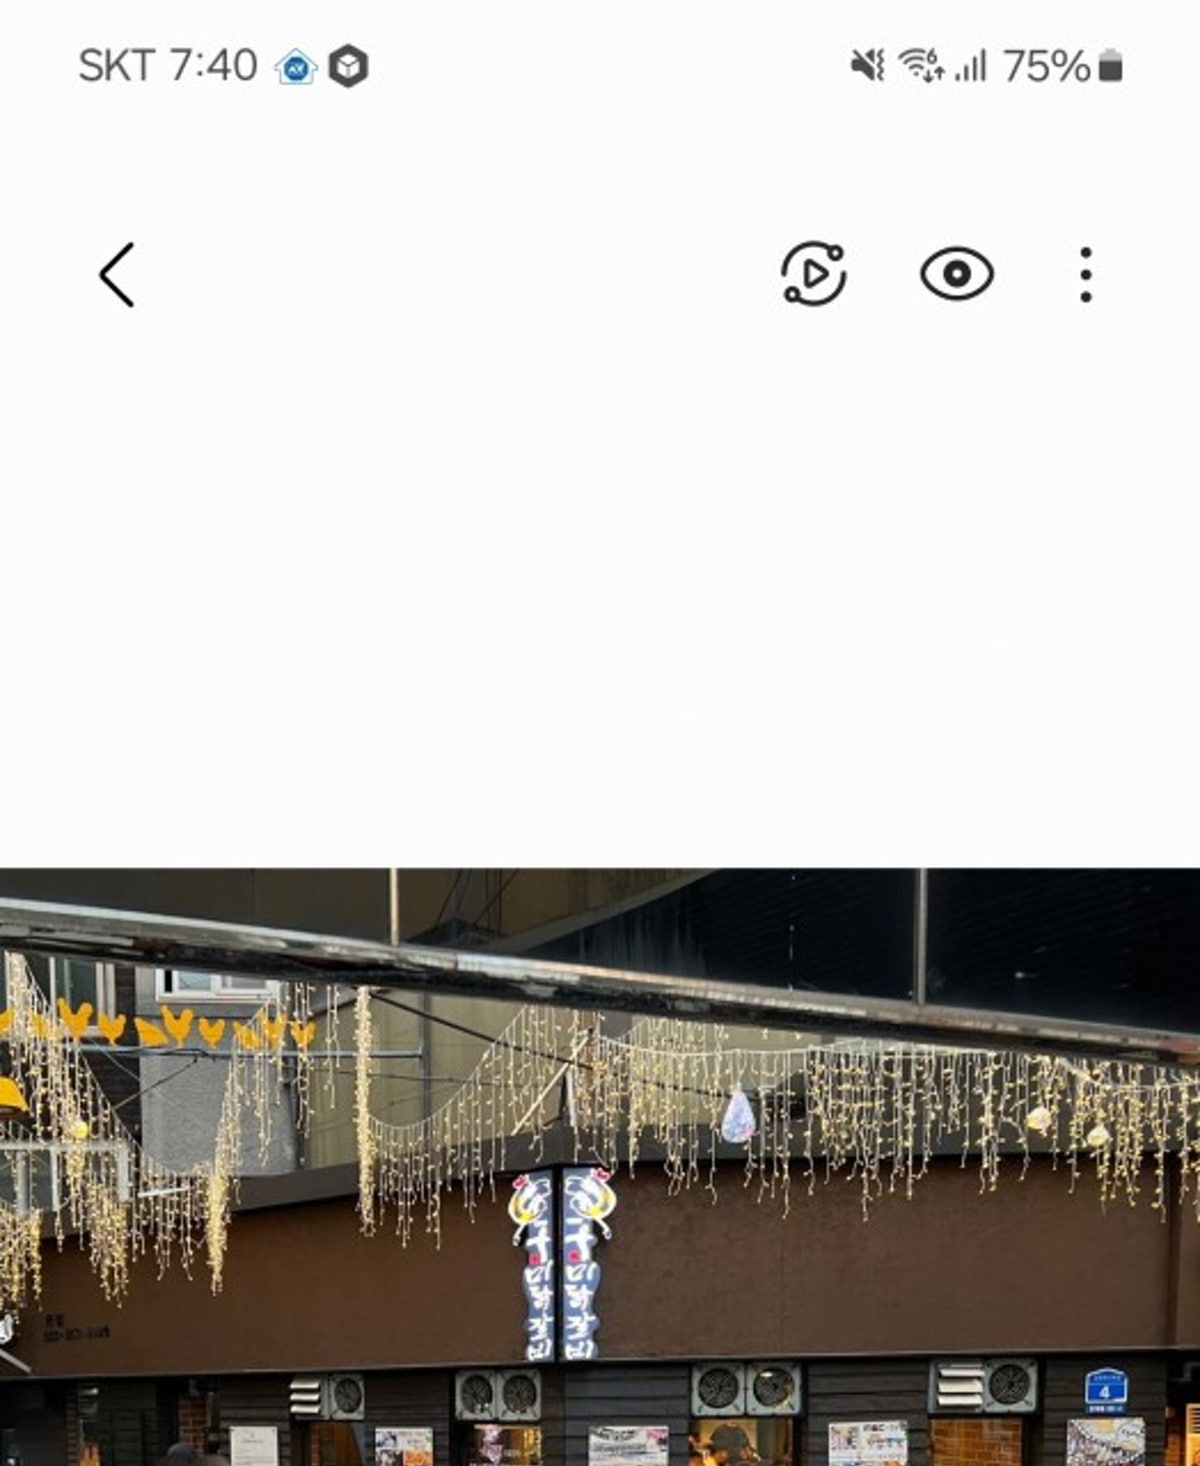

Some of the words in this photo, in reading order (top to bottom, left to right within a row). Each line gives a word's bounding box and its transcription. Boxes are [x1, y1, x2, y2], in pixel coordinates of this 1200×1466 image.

[79, 47, 156, 81] SKT
[170, 47, 257, 81] 7:40
[1003, 49, 1091, 82] 75%
[1099, 1385, 1110, 1398] 4
